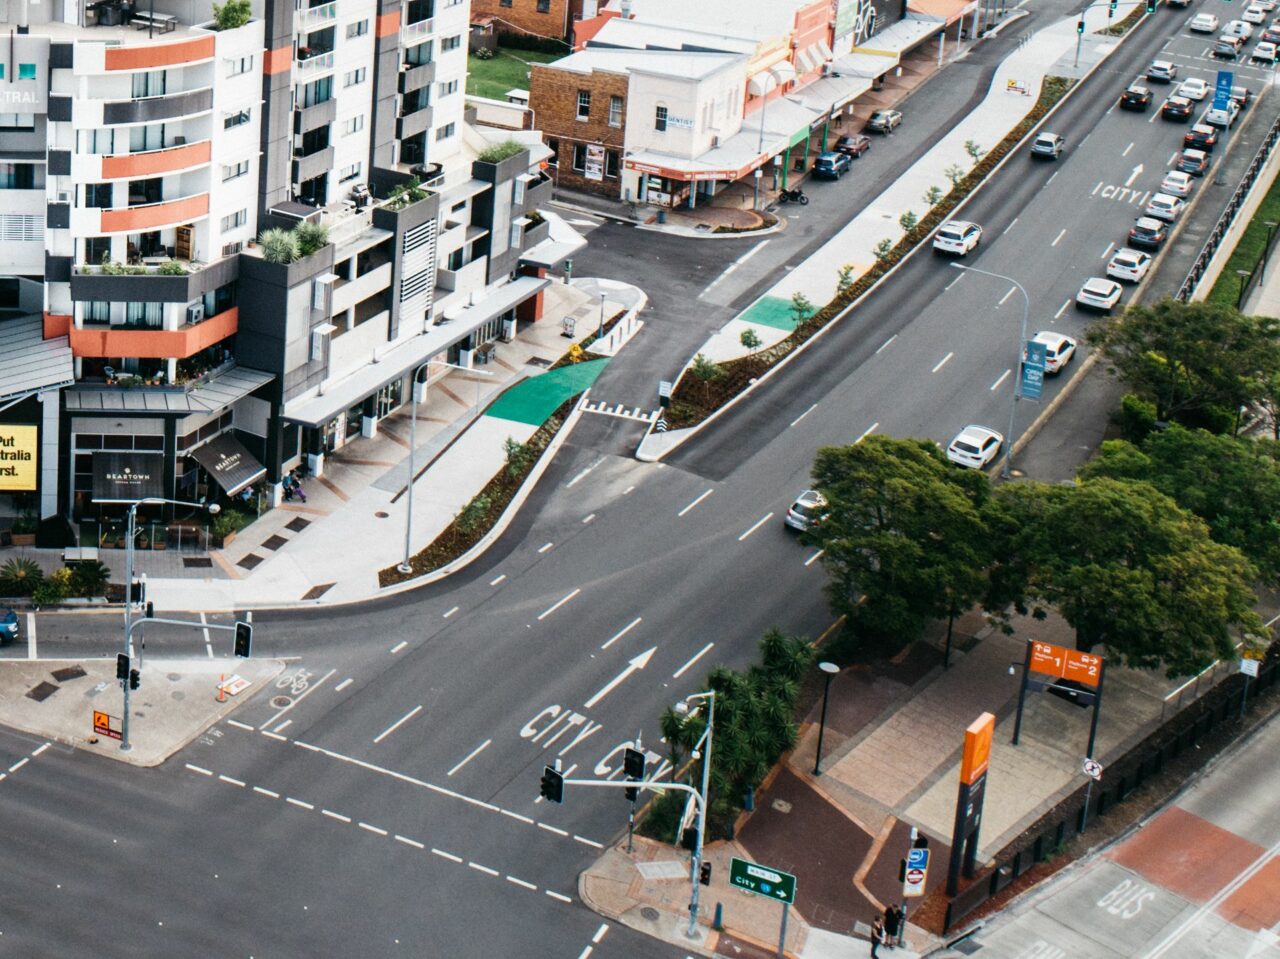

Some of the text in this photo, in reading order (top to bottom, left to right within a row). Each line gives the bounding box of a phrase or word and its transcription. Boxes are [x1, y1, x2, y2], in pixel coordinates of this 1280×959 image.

[1101, 185, 1142, 204] CITY
[1055, 657, 1061, 668] 1
[1088, 666, 1097, 677] 2
[520, 704, 603, 756] CITY
[735, 876, 756, 889] City
[1096, 878, 1156, 920] BUS
